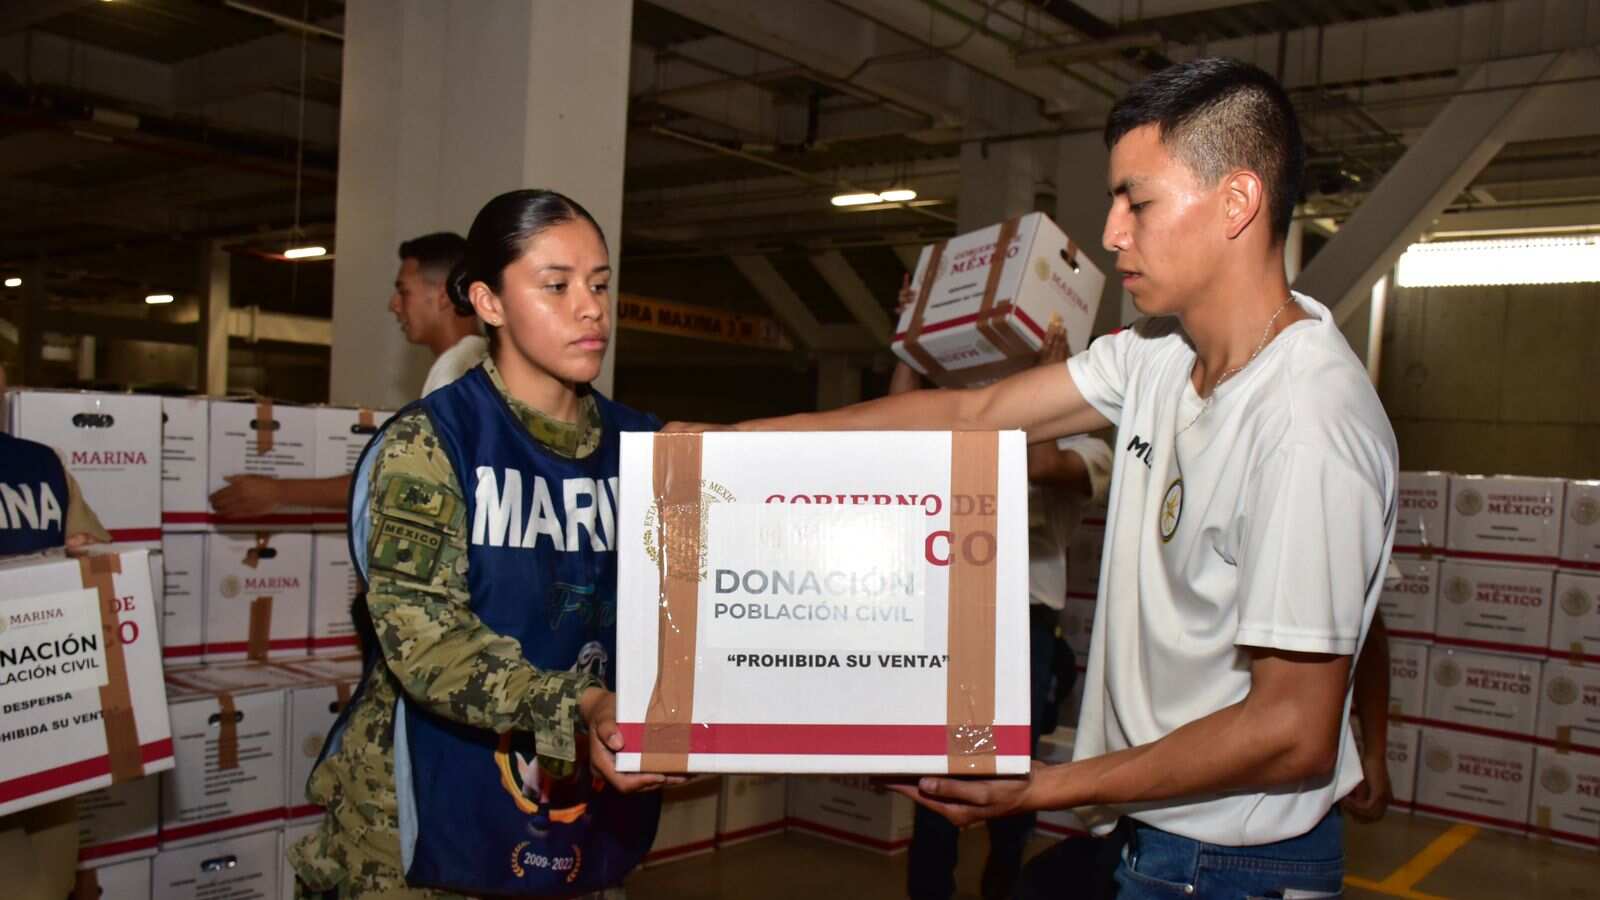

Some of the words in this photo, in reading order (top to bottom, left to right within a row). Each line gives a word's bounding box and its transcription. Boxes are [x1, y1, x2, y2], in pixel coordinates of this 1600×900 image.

[71, 450, 147, 466] MARINA
[0, 483, 62, 531] NA
[1400, 500, 1438, 510] XICO
[1487, 502, 1554, 517] MÉXICO
[384, 522, 439, 546] MEXICO
[244, 577, 299, 589] MARINA
[1476, 590, 1543, 607] MÉXICO
[10, 608, 64, 625] MARINA
[714, 601, 848, 622] POBLACIÓN
[855, 604, 914, 622] CIVIL
[0, 633, 98, 668] NACIÓN
[846, 654, 871, 668] SU
[0, 663, 57, 686] LACIÓN
[61, 657, 99, 674] CIVIL
[1466, 675, 1532, 694] MÉXICO
[3, 691, 73, 715] DESPENSA
[0, 724, 49, 744] HIBIDA
[52, 717, 69, 730] SU
[73, 709, 105, 725] VENT
[1458, 762, 1523, 782] MÉXICO
